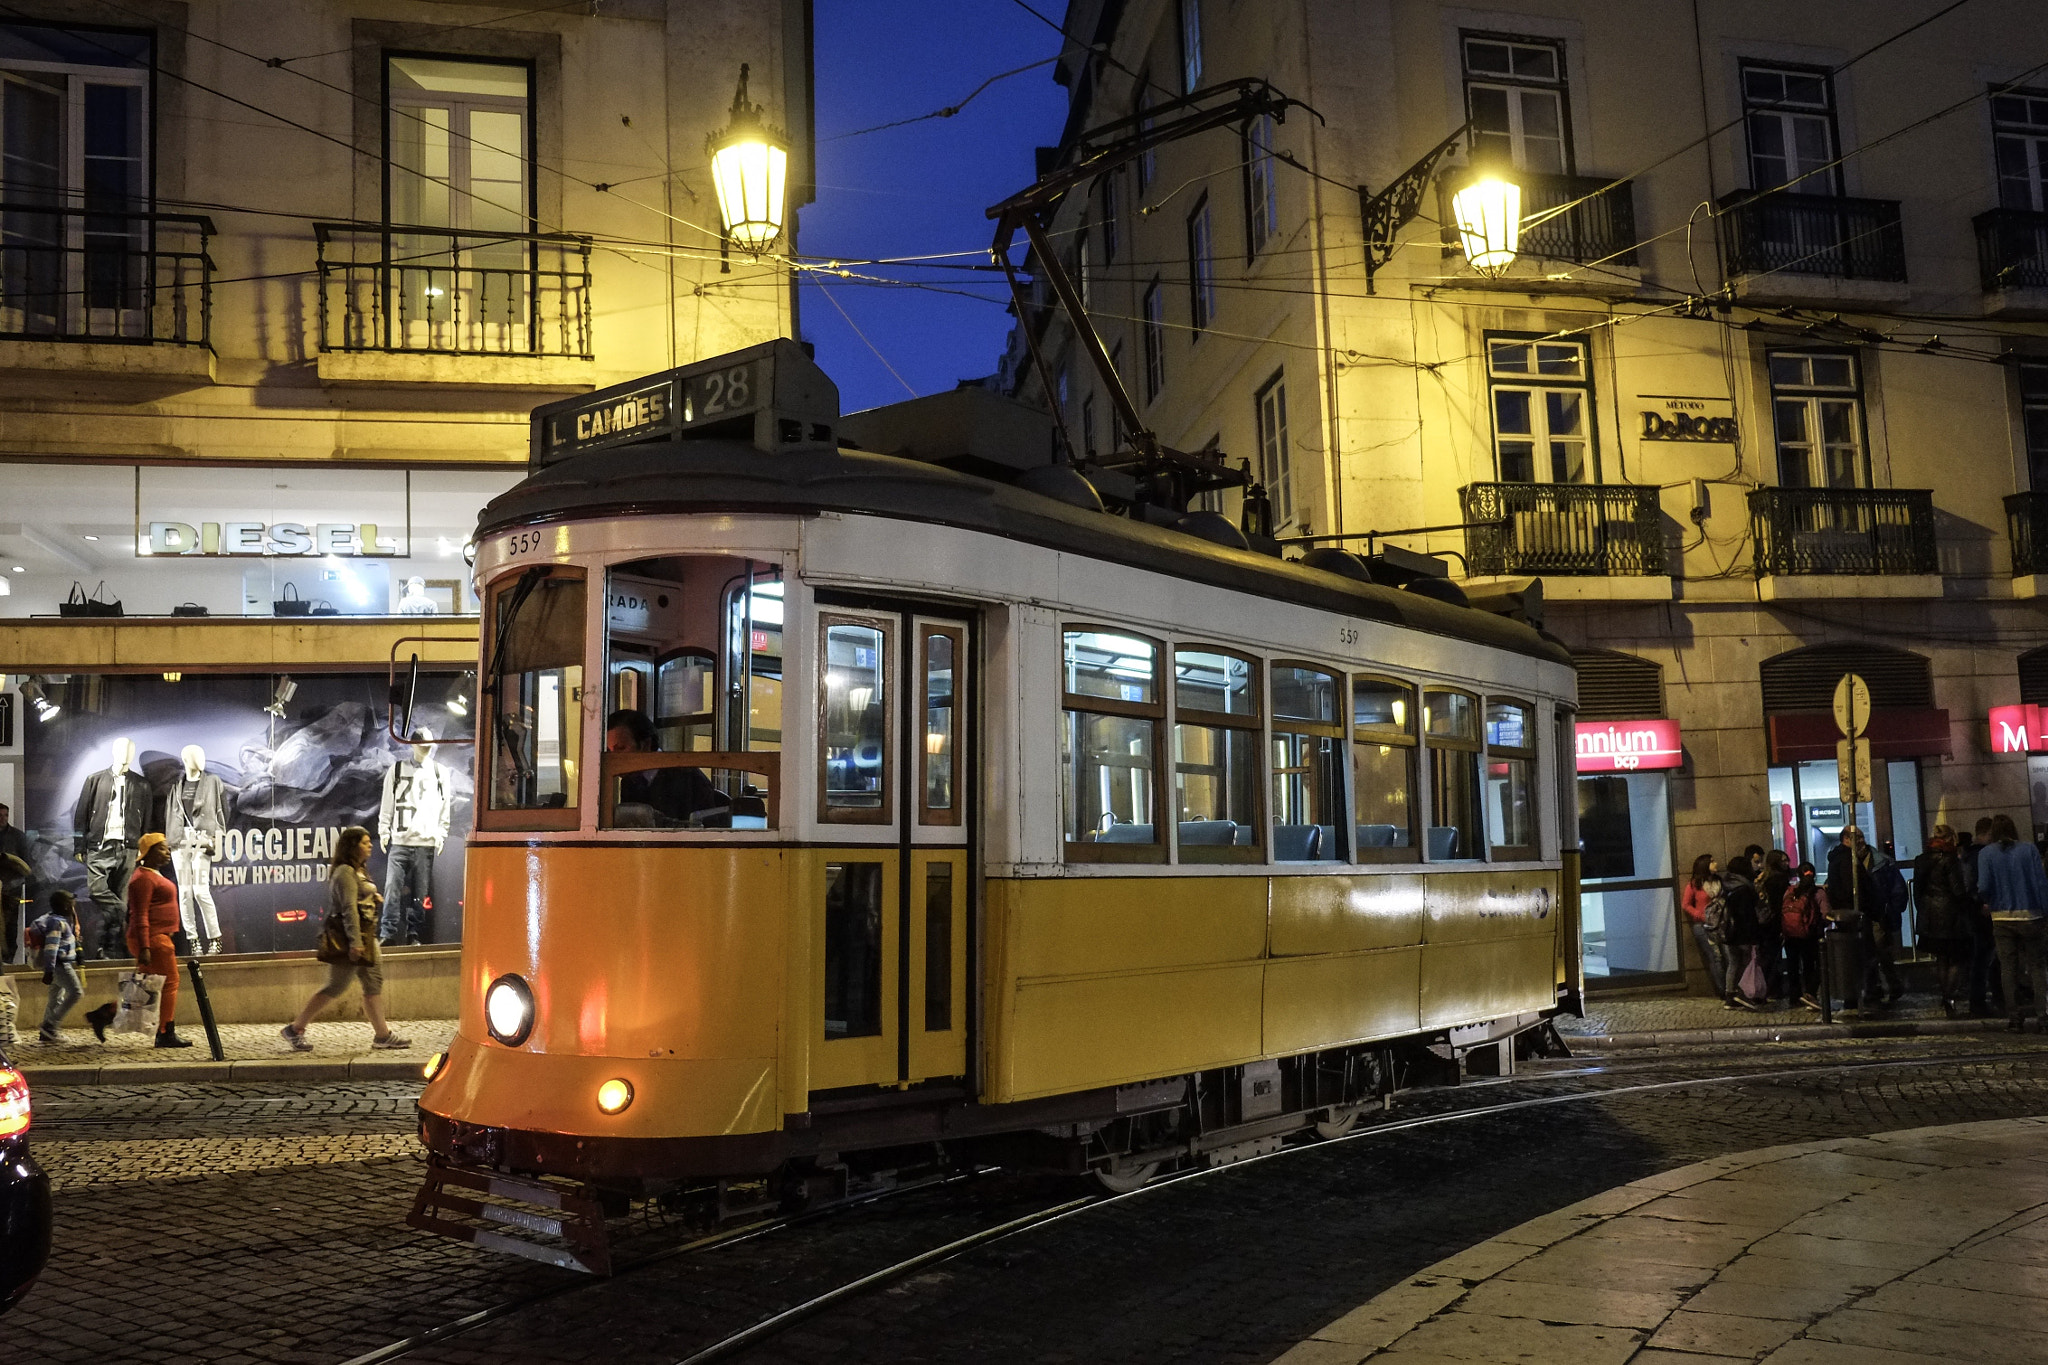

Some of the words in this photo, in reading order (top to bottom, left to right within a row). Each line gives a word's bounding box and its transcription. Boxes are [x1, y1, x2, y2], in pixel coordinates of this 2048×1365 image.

[703, 366, 749, 415] 28
[149, 522, 395, 555] DIESEL
[510, 530, 541, 556] 559
[1340, 628, 1358, 645] 559
[1576, 726, 1658, 753] nnium
[1999, 721, 2029, 752] M
[1614, 753, 1640, 770] bcp
[213, 866, 248, 885] NEW
[253, 864, 312, 885] HYBRID
